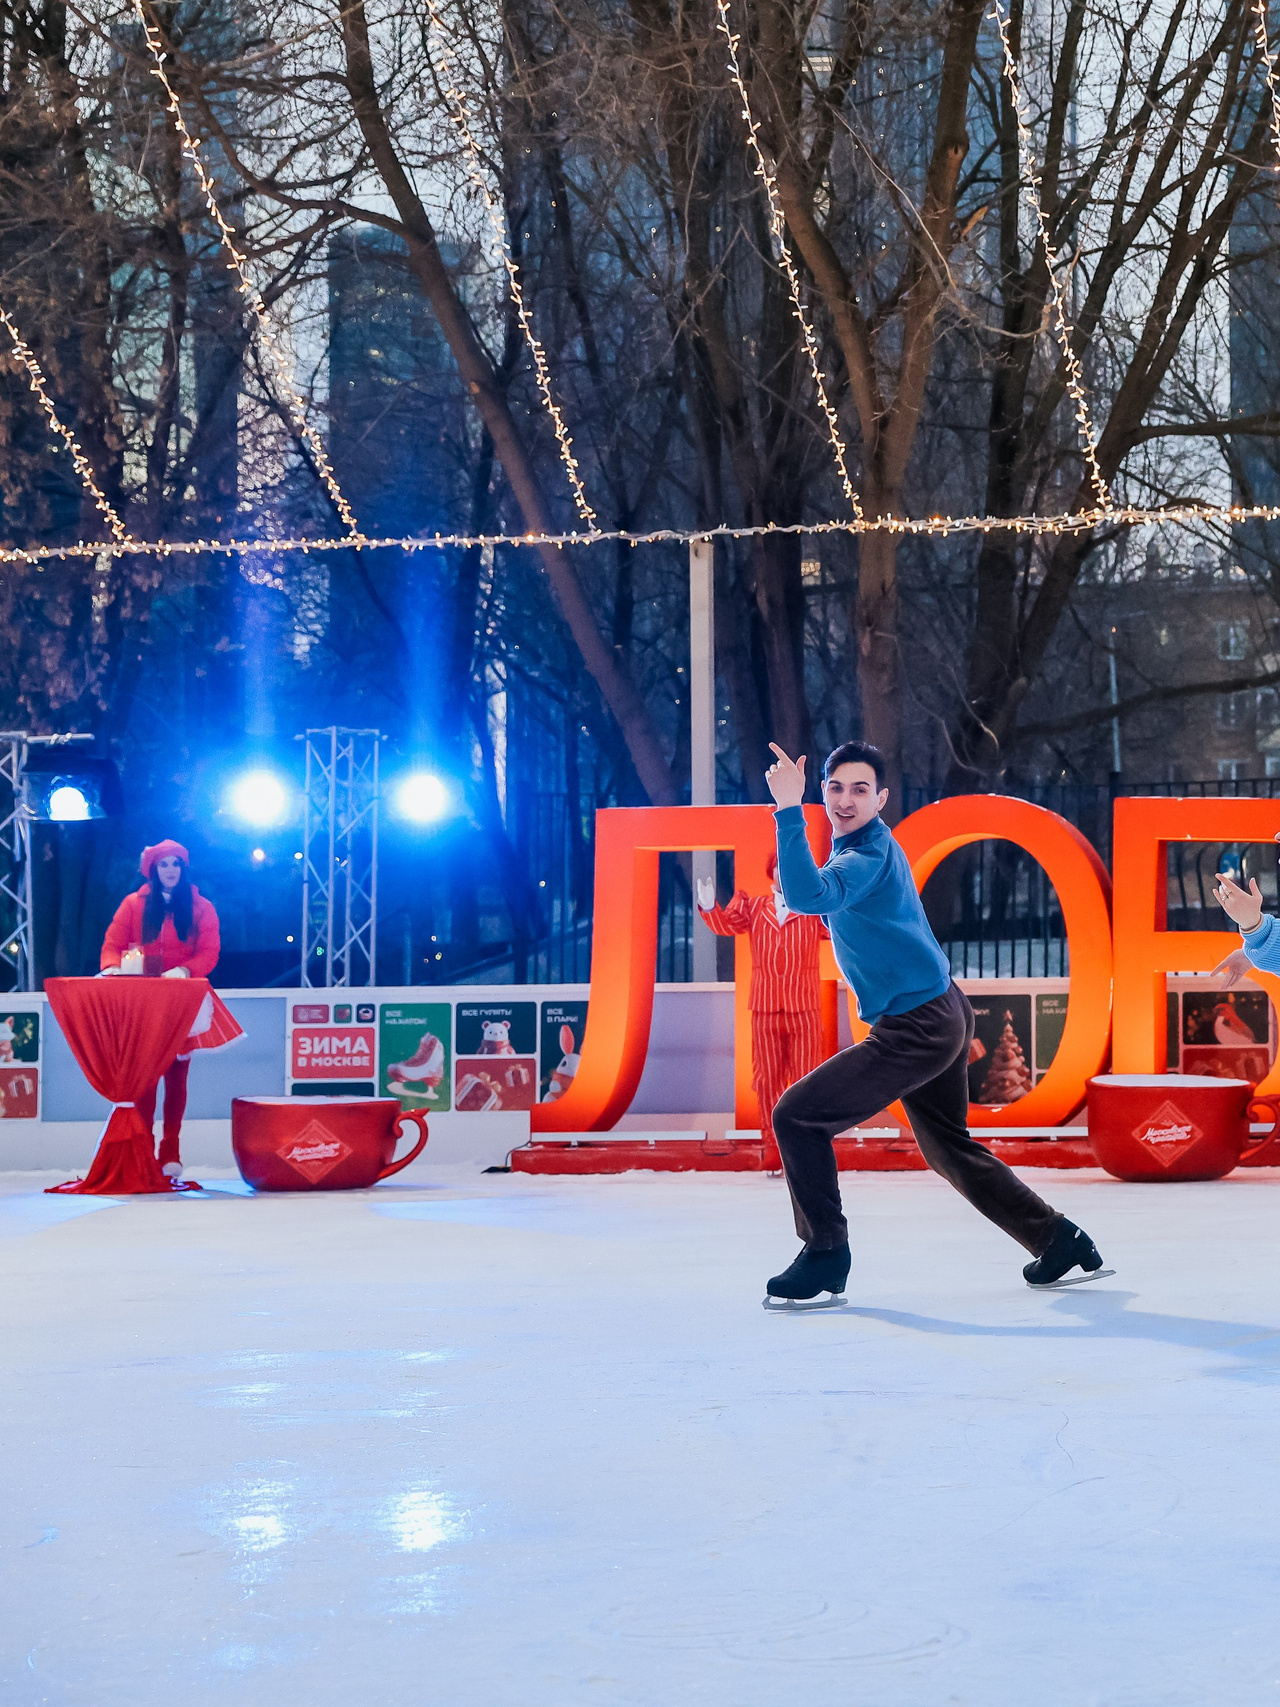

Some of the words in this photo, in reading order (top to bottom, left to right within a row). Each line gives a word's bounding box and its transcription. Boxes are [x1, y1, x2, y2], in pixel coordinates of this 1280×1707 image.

[298, 1036, 370, 1055] ЗИМА
[297, 1056, 307, 1067] В
[311, 1055, 370, 1067] МОСКВЕ
